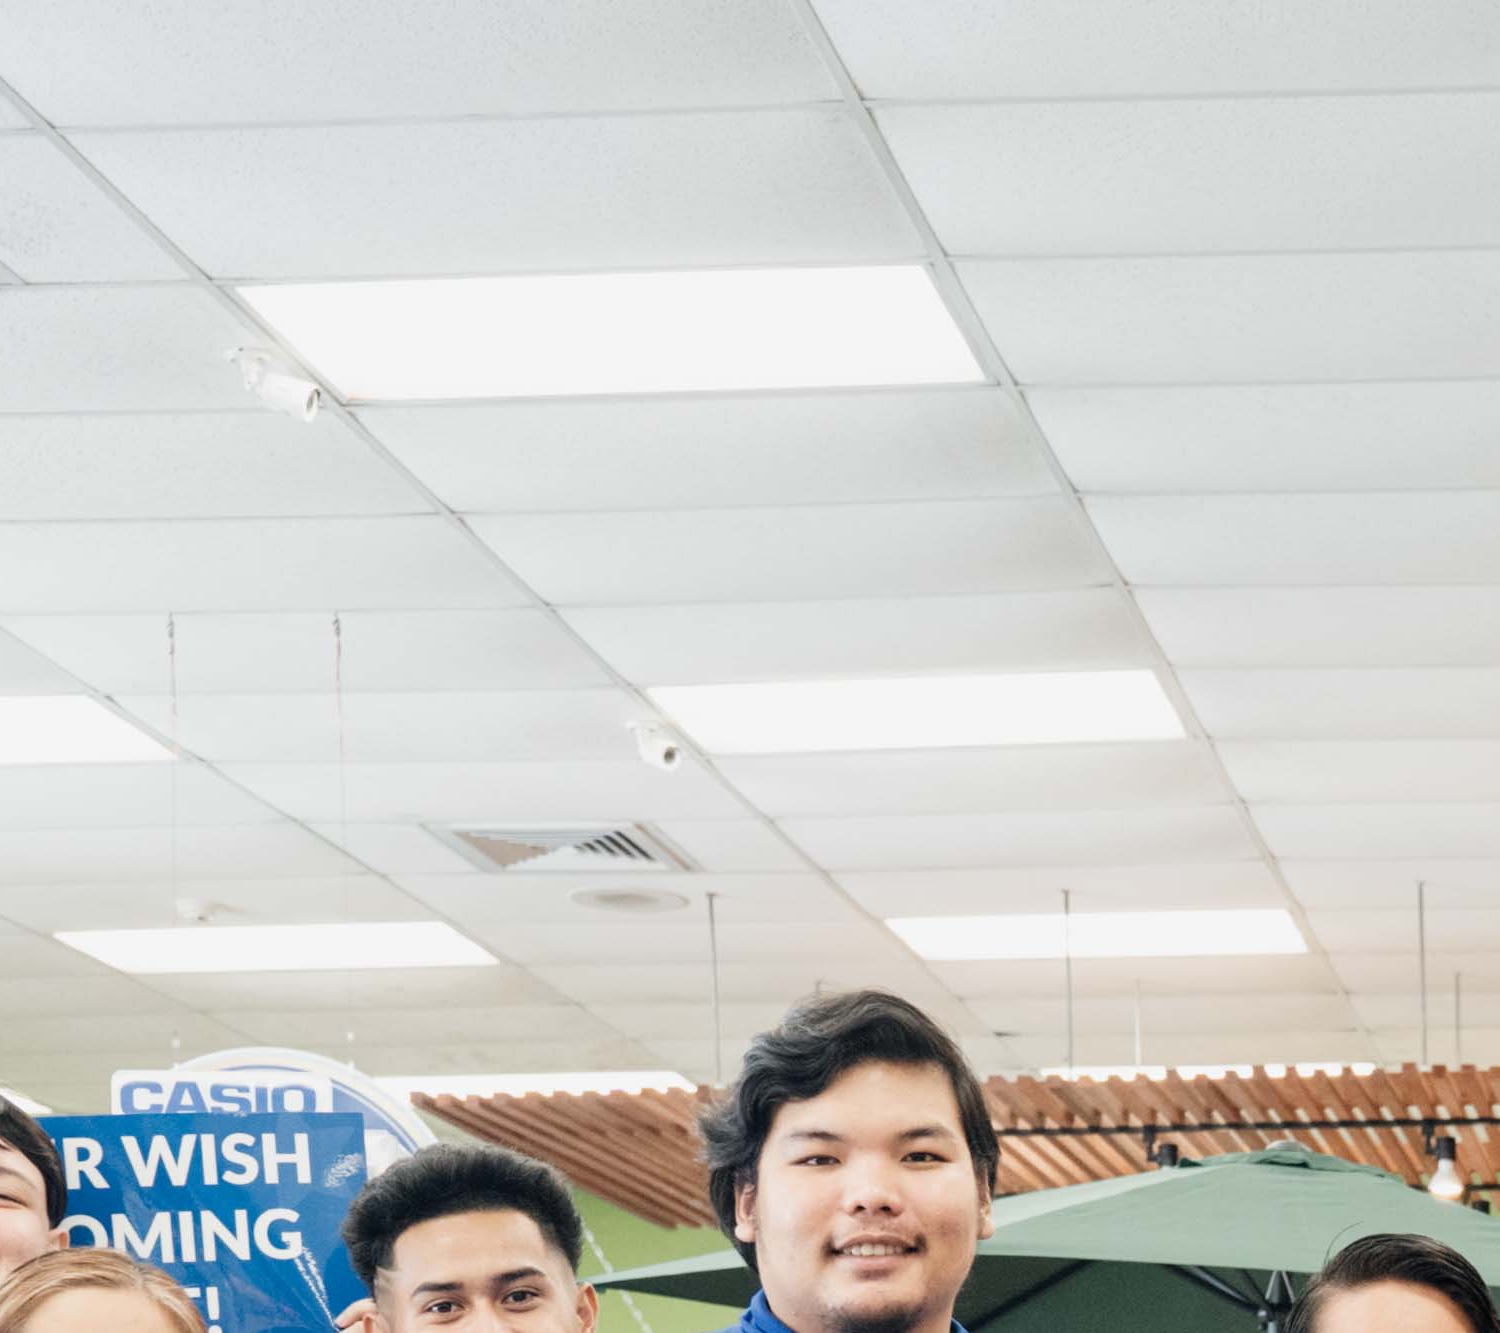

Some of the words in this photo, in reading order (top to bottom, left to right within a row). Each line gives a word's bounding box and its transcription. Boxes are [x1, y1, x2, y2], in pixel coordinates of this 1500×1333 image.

[119, 1077, 318, 1115] CASIO
[119, 1133, 311, 1188] WISH
[67, 1208, 303, 1264] OMING
